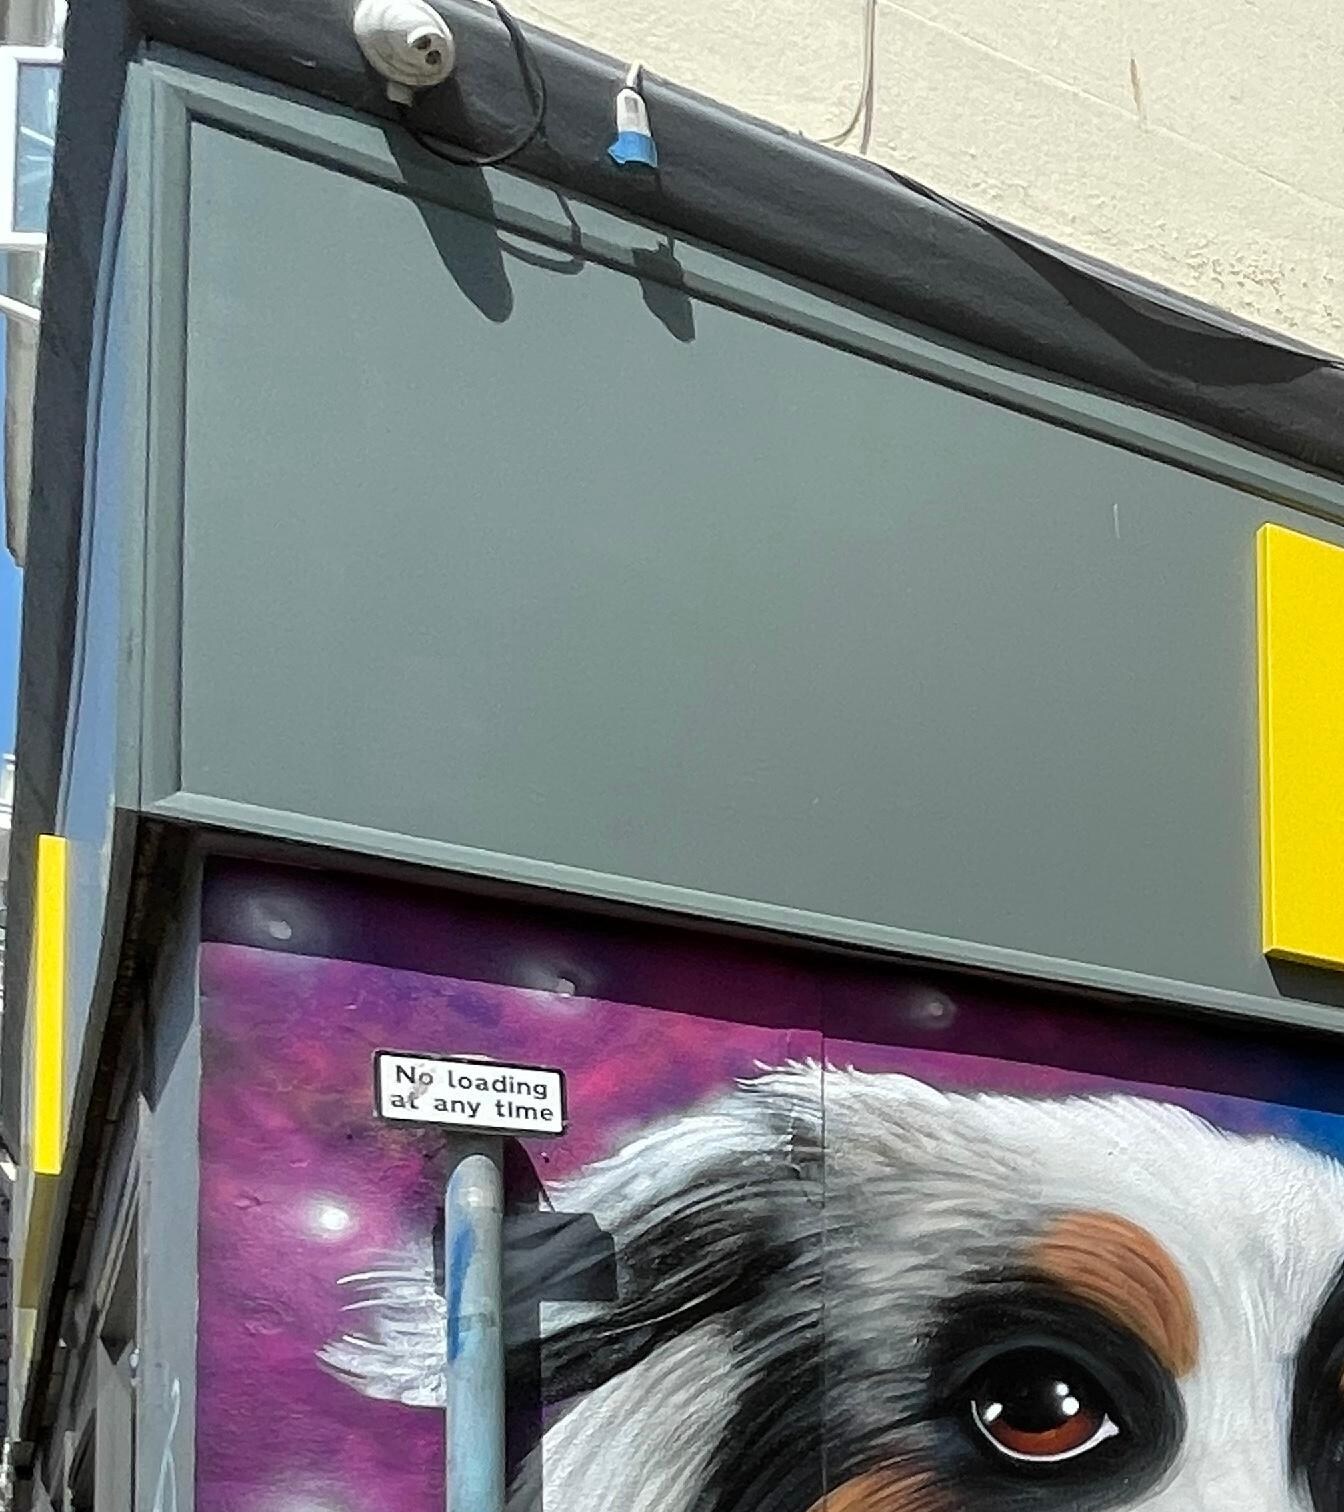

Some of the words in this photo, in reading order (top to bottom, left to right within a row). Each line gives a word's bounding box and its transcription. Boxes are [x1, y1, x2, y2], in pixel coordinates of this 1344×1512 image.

[396, 1065, 434, 1086] No
[448, 1070, 548, 1100] loading
[390, 1091, 420, 1110] at
[434, 1097, 482, 1118] any
[495, 1100, 554, 1122] time
